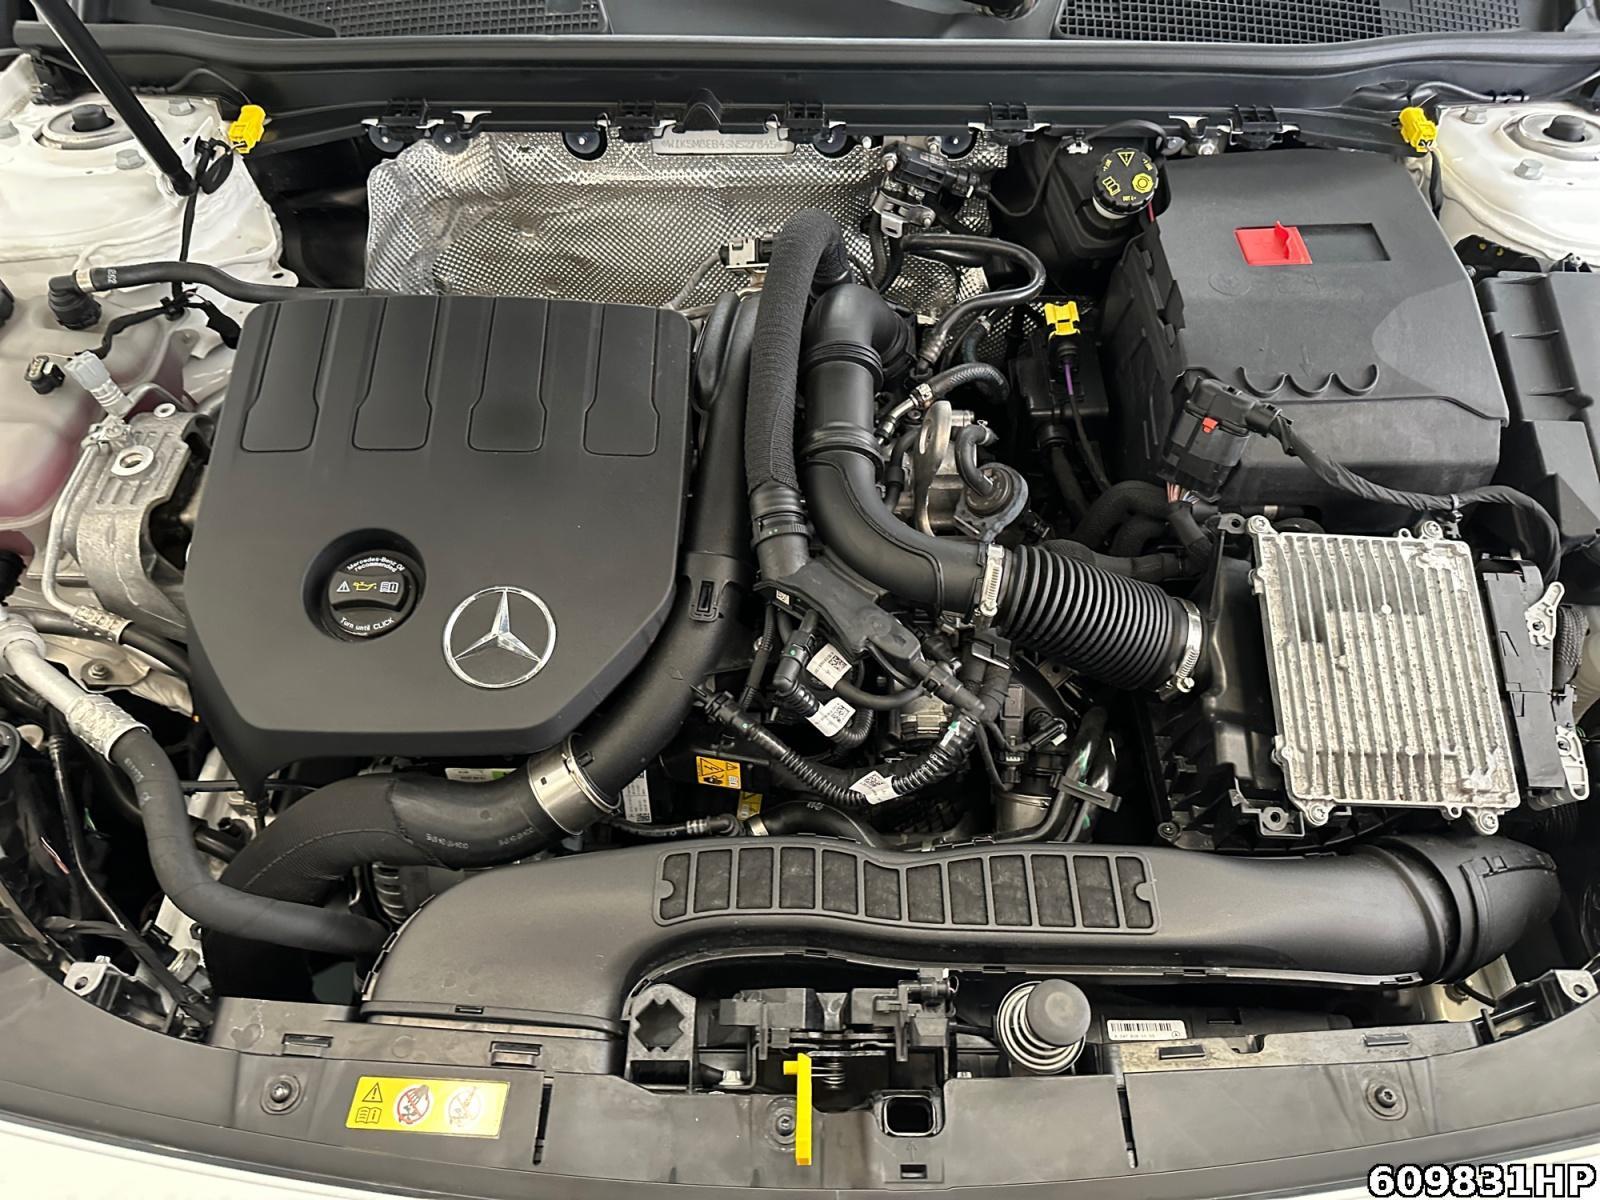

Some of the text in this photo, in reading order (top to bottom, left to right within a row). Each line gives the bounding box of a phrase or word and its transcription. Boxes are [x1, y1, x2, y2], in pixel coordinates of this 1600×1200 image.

[346, 557, 398, 571] Mercedes-Benz
[354, 562, 397, 572] recommended
[340, 617, 354, 629] Turn
[373, 617, 395, 630] CLICK
